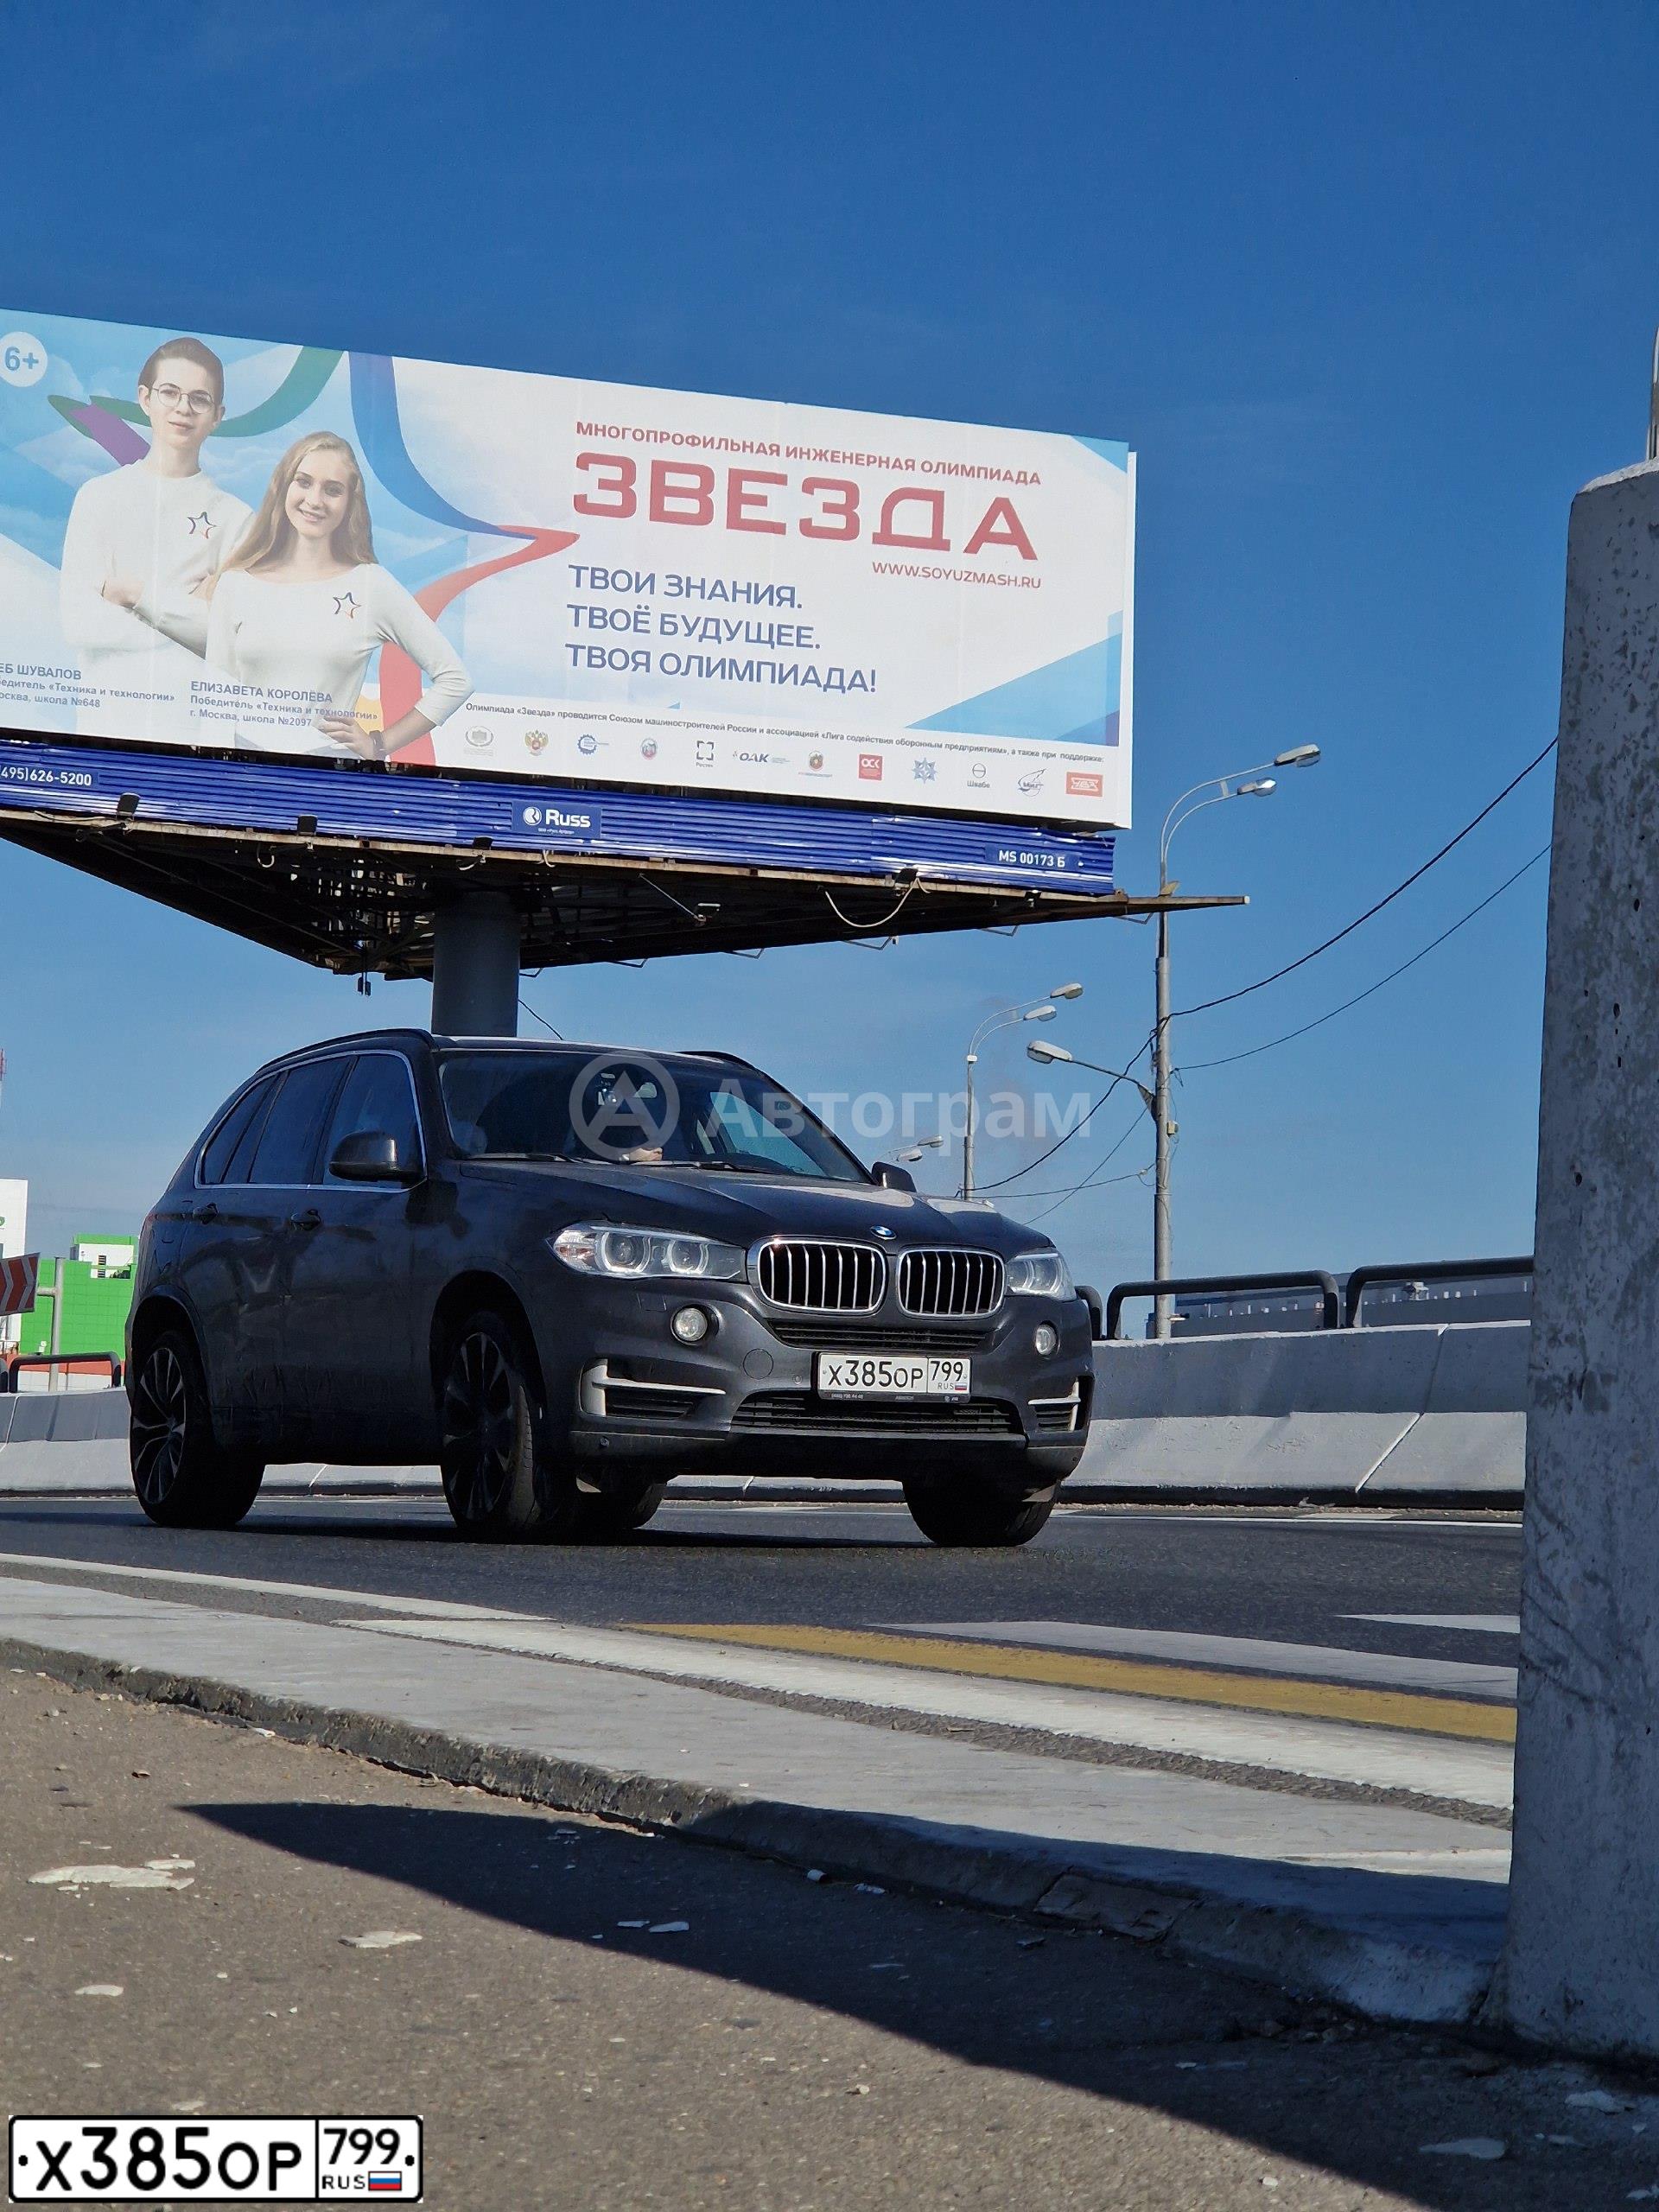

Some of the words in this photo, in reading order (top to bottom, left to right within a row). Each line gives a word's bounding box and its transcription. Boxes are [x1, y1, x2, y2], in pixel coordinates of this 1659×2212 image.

[5, 346, 39, 372] 6+
[576, 422, 780, 457] МНОГОПРОФИЛЬНАЯ
[785, 445, 916, 472] ИНЖЕНЕРНАЯ
[920, 461, 1041, 486] ОЛИМПИАДА
[573, 452, 1038, 560] ЗВЕЗДА
[569, 564, 656, 594] ТВОИ
[664, 575, 802, 609] ЗНАНИЯ.
[872, 562, 1041, 589] WWW.SOYUZMASH.RU
[567, 604, 651, 633] ТВОЁ
[659, 613, 820, 649] БУДУЩЕЕ.
[17, 664, 82, 680] ШУВАЛОВ
[565, 643, 650, 672] ТВОЯ
[659, 652, 876, 694] ОЛИМПИАДА!
[0, 679, 46, 690] едитель
[49, 683, 97, 695] «Техника
[110, 690, 175, 702] технологии»
[35, 696, 68, 705] школа
[71, 697, 101, 708] №648
[191, 681, 264, 697] ЕЛИЗАВЕТА
[268, 689, 333, 703] КОРОЛЕВА
[191, 695, 253, 709] Победитель
[257, 702, 302, 714] «Техника
[315, 708, 378, 720] технологии»
[200, 709, 239, 721] Москва,
[243, 715, 276, 724] школа
[278, 716, 312, 727] №2097
[466, 703, 515, 715] Олимпиада
[518, 707, 556, 719] «Звезда»
[557, 711, 607, 721] проводится
[609, 715, 643, 724] Союзом
[645, 718, 726, 731] машиностроителей
[728, 724, 757, 734] России
[766, 728, 819, 739] ассоциацией
[847, 734, 893, 745] содействия
[895, 739, 943, 749] оборонным
[1018, 749, 1039, 758] также
[545, 809, 591, 828] Russ
[998, 850, 1017, 862] MS
[1020, 852, 1054, 867] 00173
[828, 1359, 924, 1389] Х385ОР
[930, 1361, 963, 1382] 799
